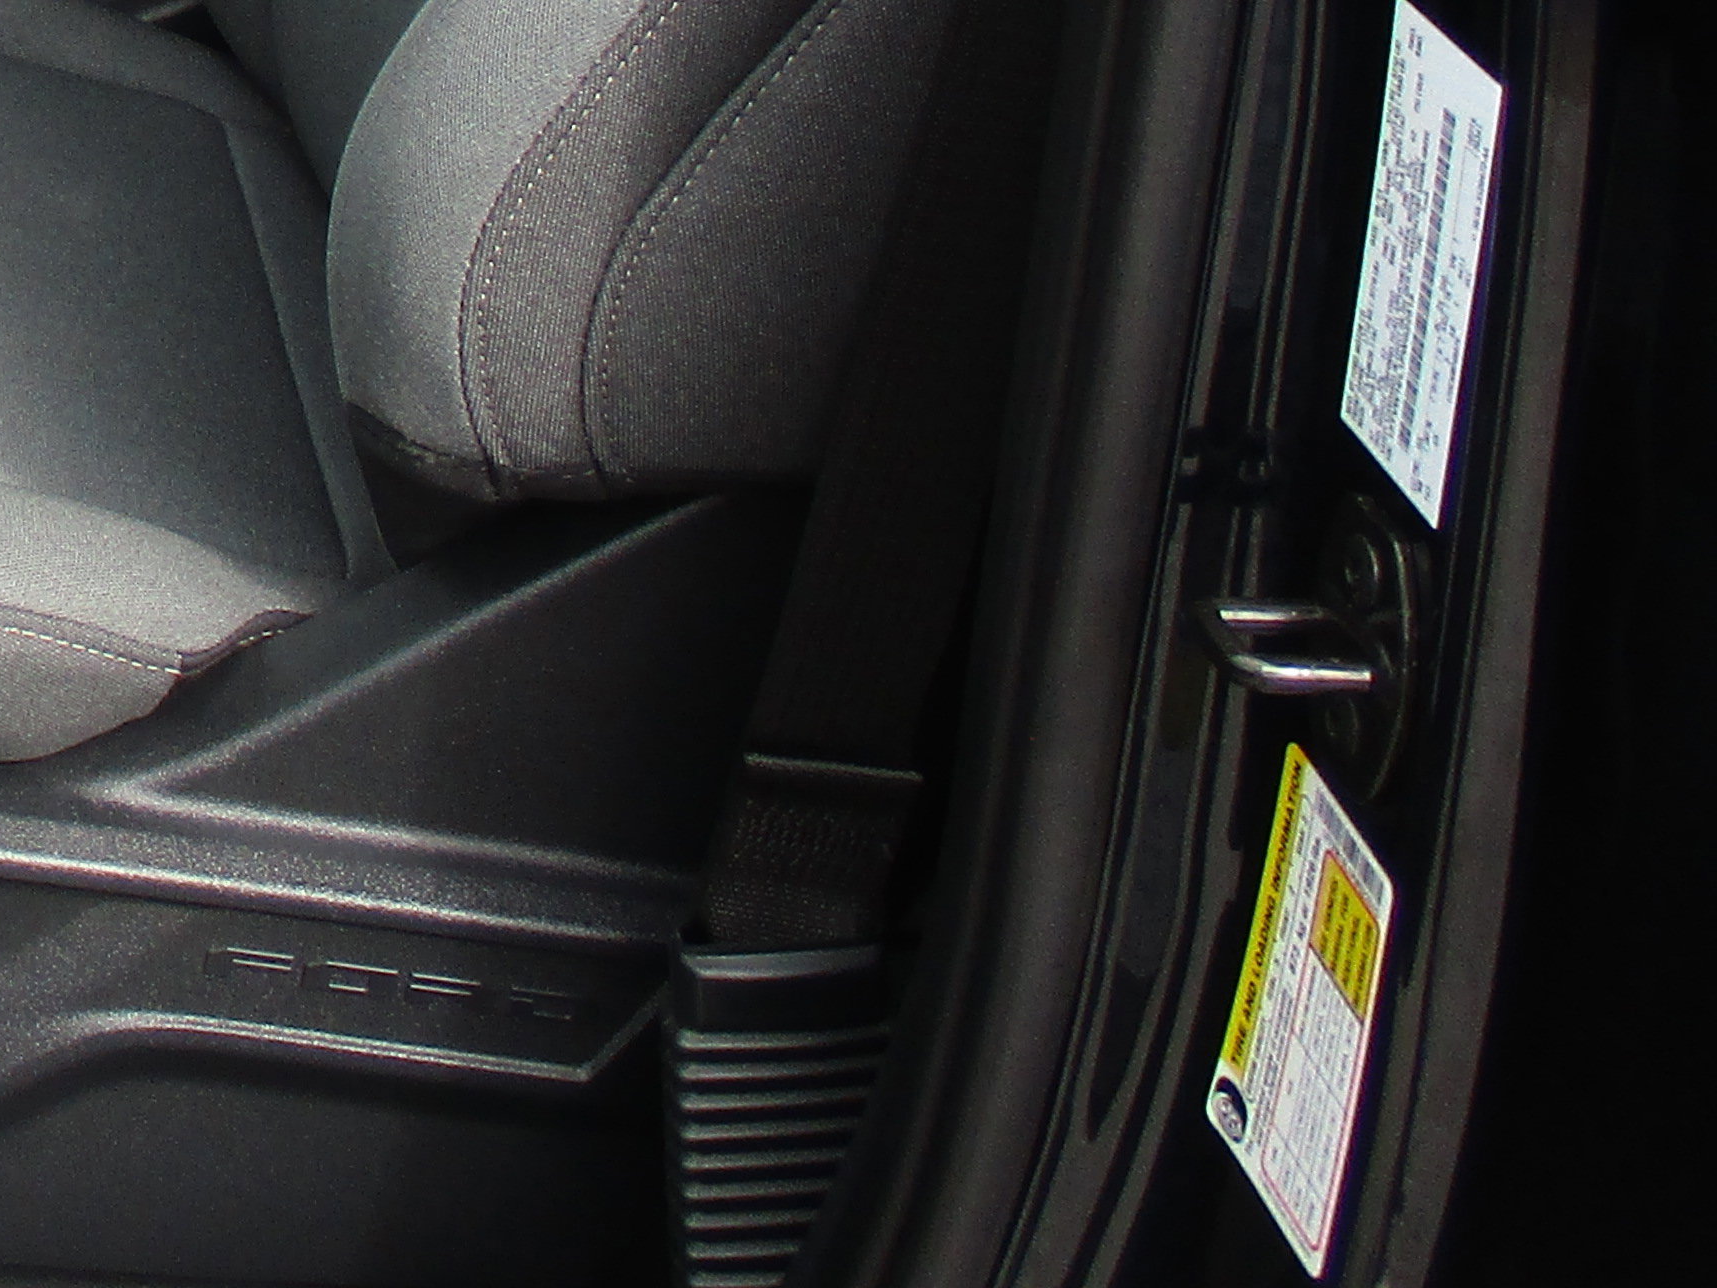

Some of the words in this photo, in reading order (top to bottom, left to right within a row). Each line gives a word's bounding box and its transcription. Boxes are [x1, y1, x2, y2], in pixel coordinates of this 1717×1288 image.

[1230, 1029, 1249, 1065] TIRE
[1243, 984, 1258, 1022] AND
[1252, 894, 1277, 980] LOADING
[1271, 760, 1303, 890] INFORMATION
